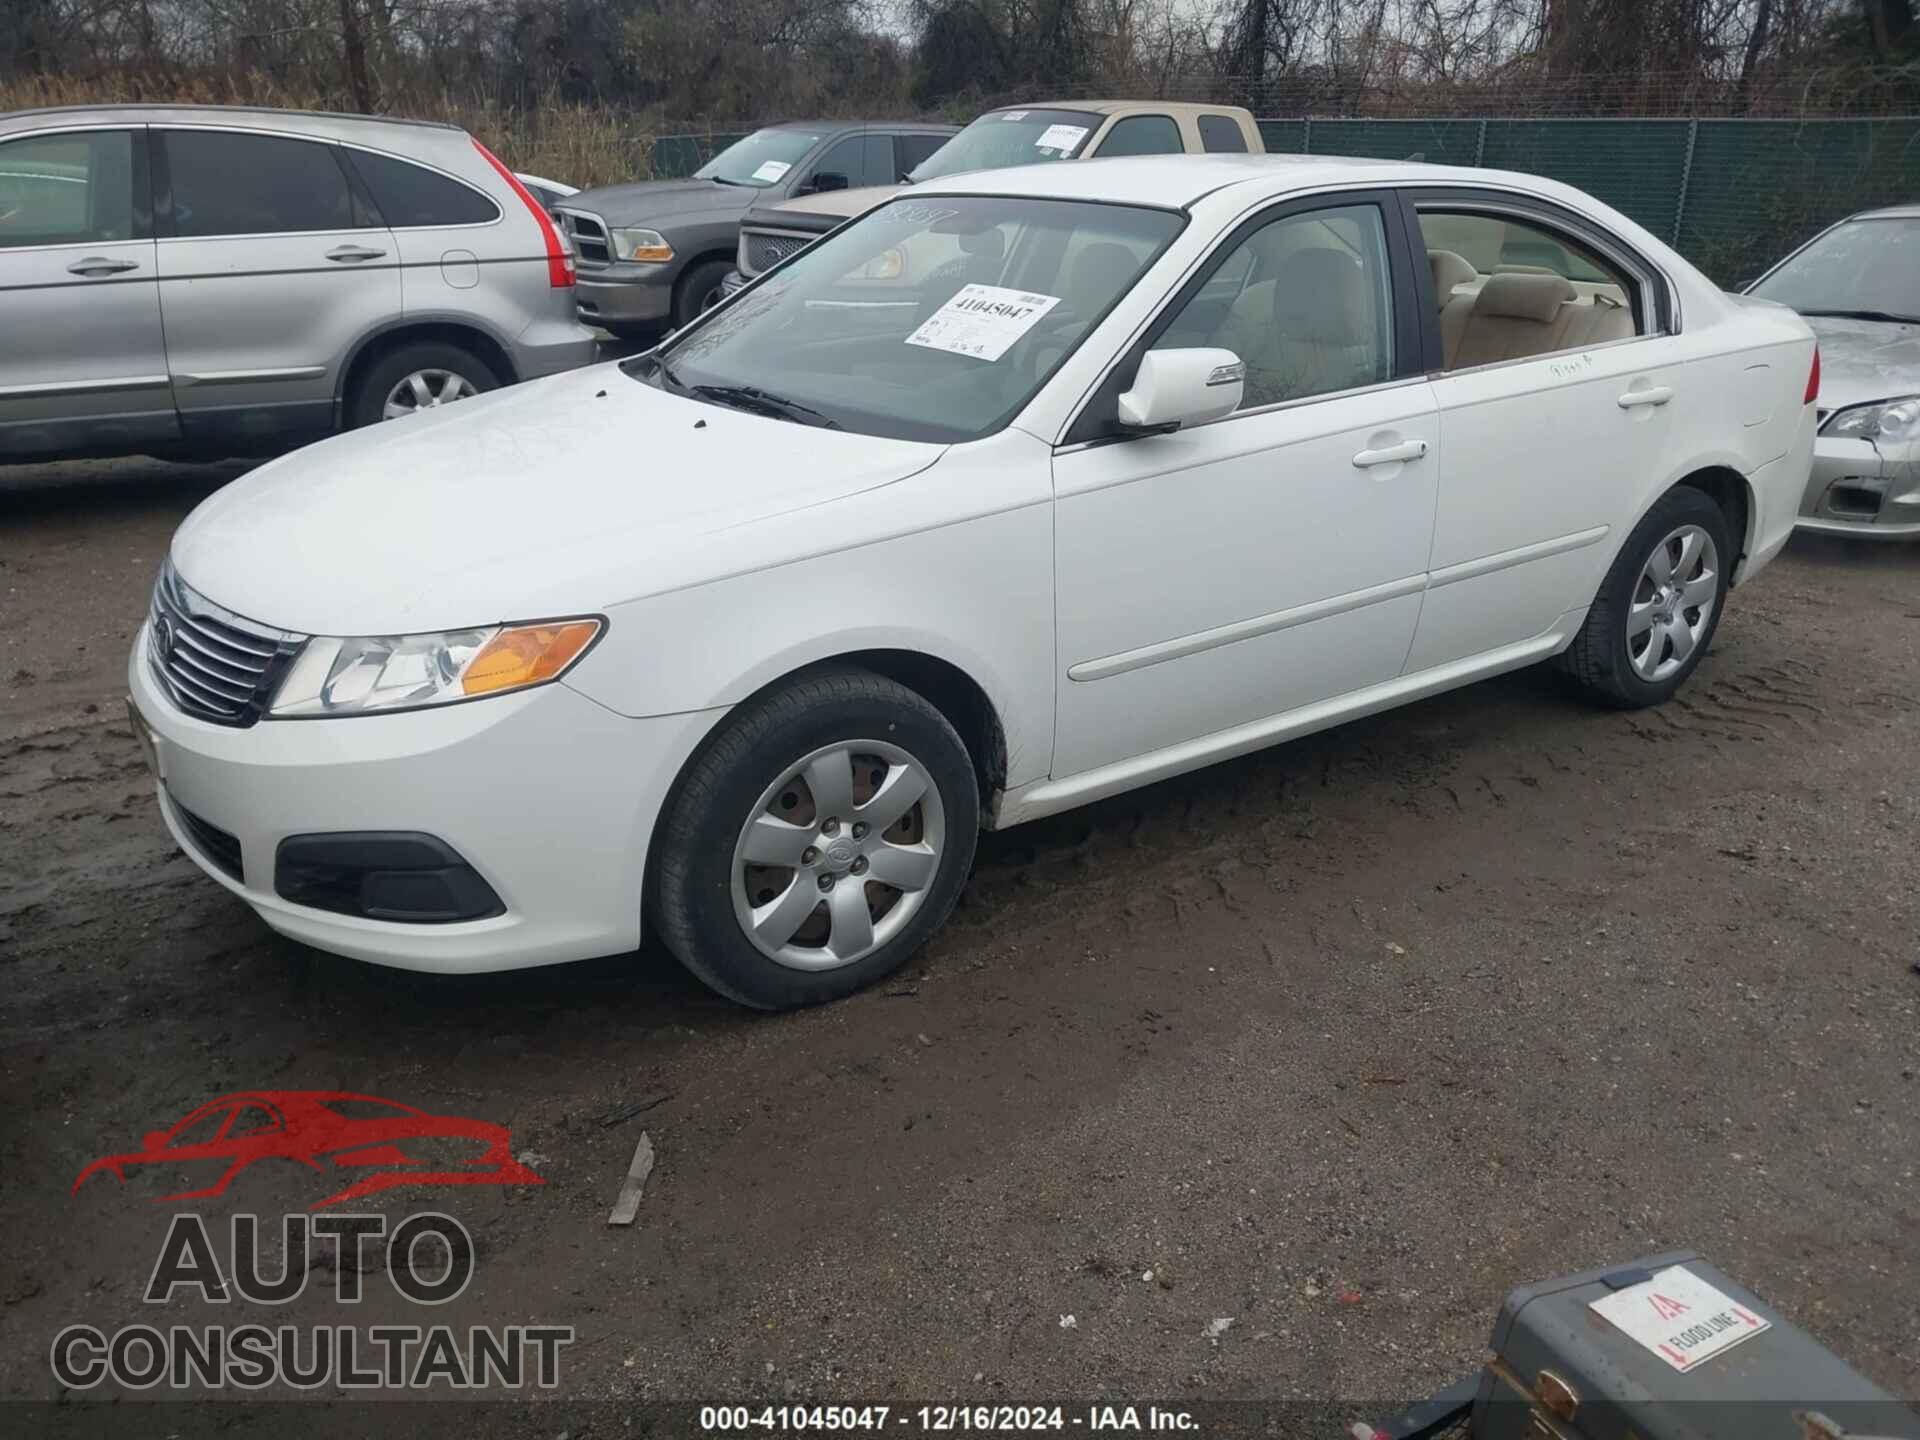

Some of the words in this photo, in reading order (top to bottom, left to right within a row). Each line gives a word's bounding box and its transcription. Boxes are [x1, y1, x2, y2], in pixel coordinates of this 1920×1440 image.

[956, 299, 1034, 320] 41045047
[1668, 1324, 1714, 1352] FLOOD
[1703, 1311, 1740, 1334] LINE
